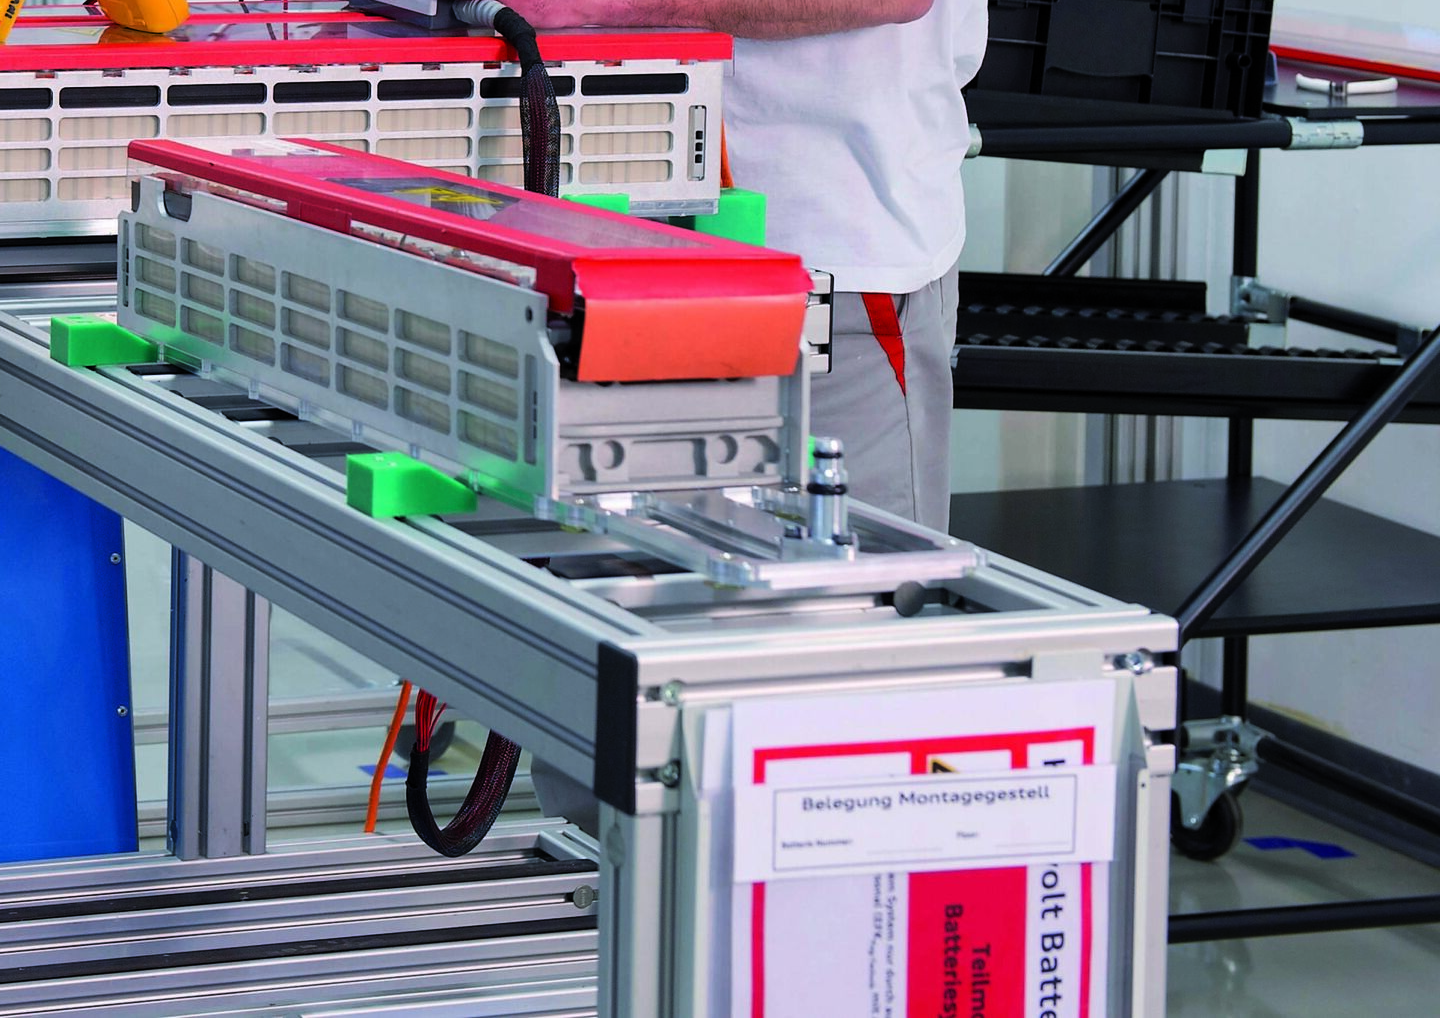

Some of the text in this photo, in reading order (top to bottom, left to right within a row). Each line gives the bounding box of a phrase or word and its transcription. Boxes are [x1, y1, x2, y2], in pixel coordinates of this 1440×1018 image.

[801, 785, 1050, 813] Belegung Montagegestell
[1040, 863, 1066, 920] olt
